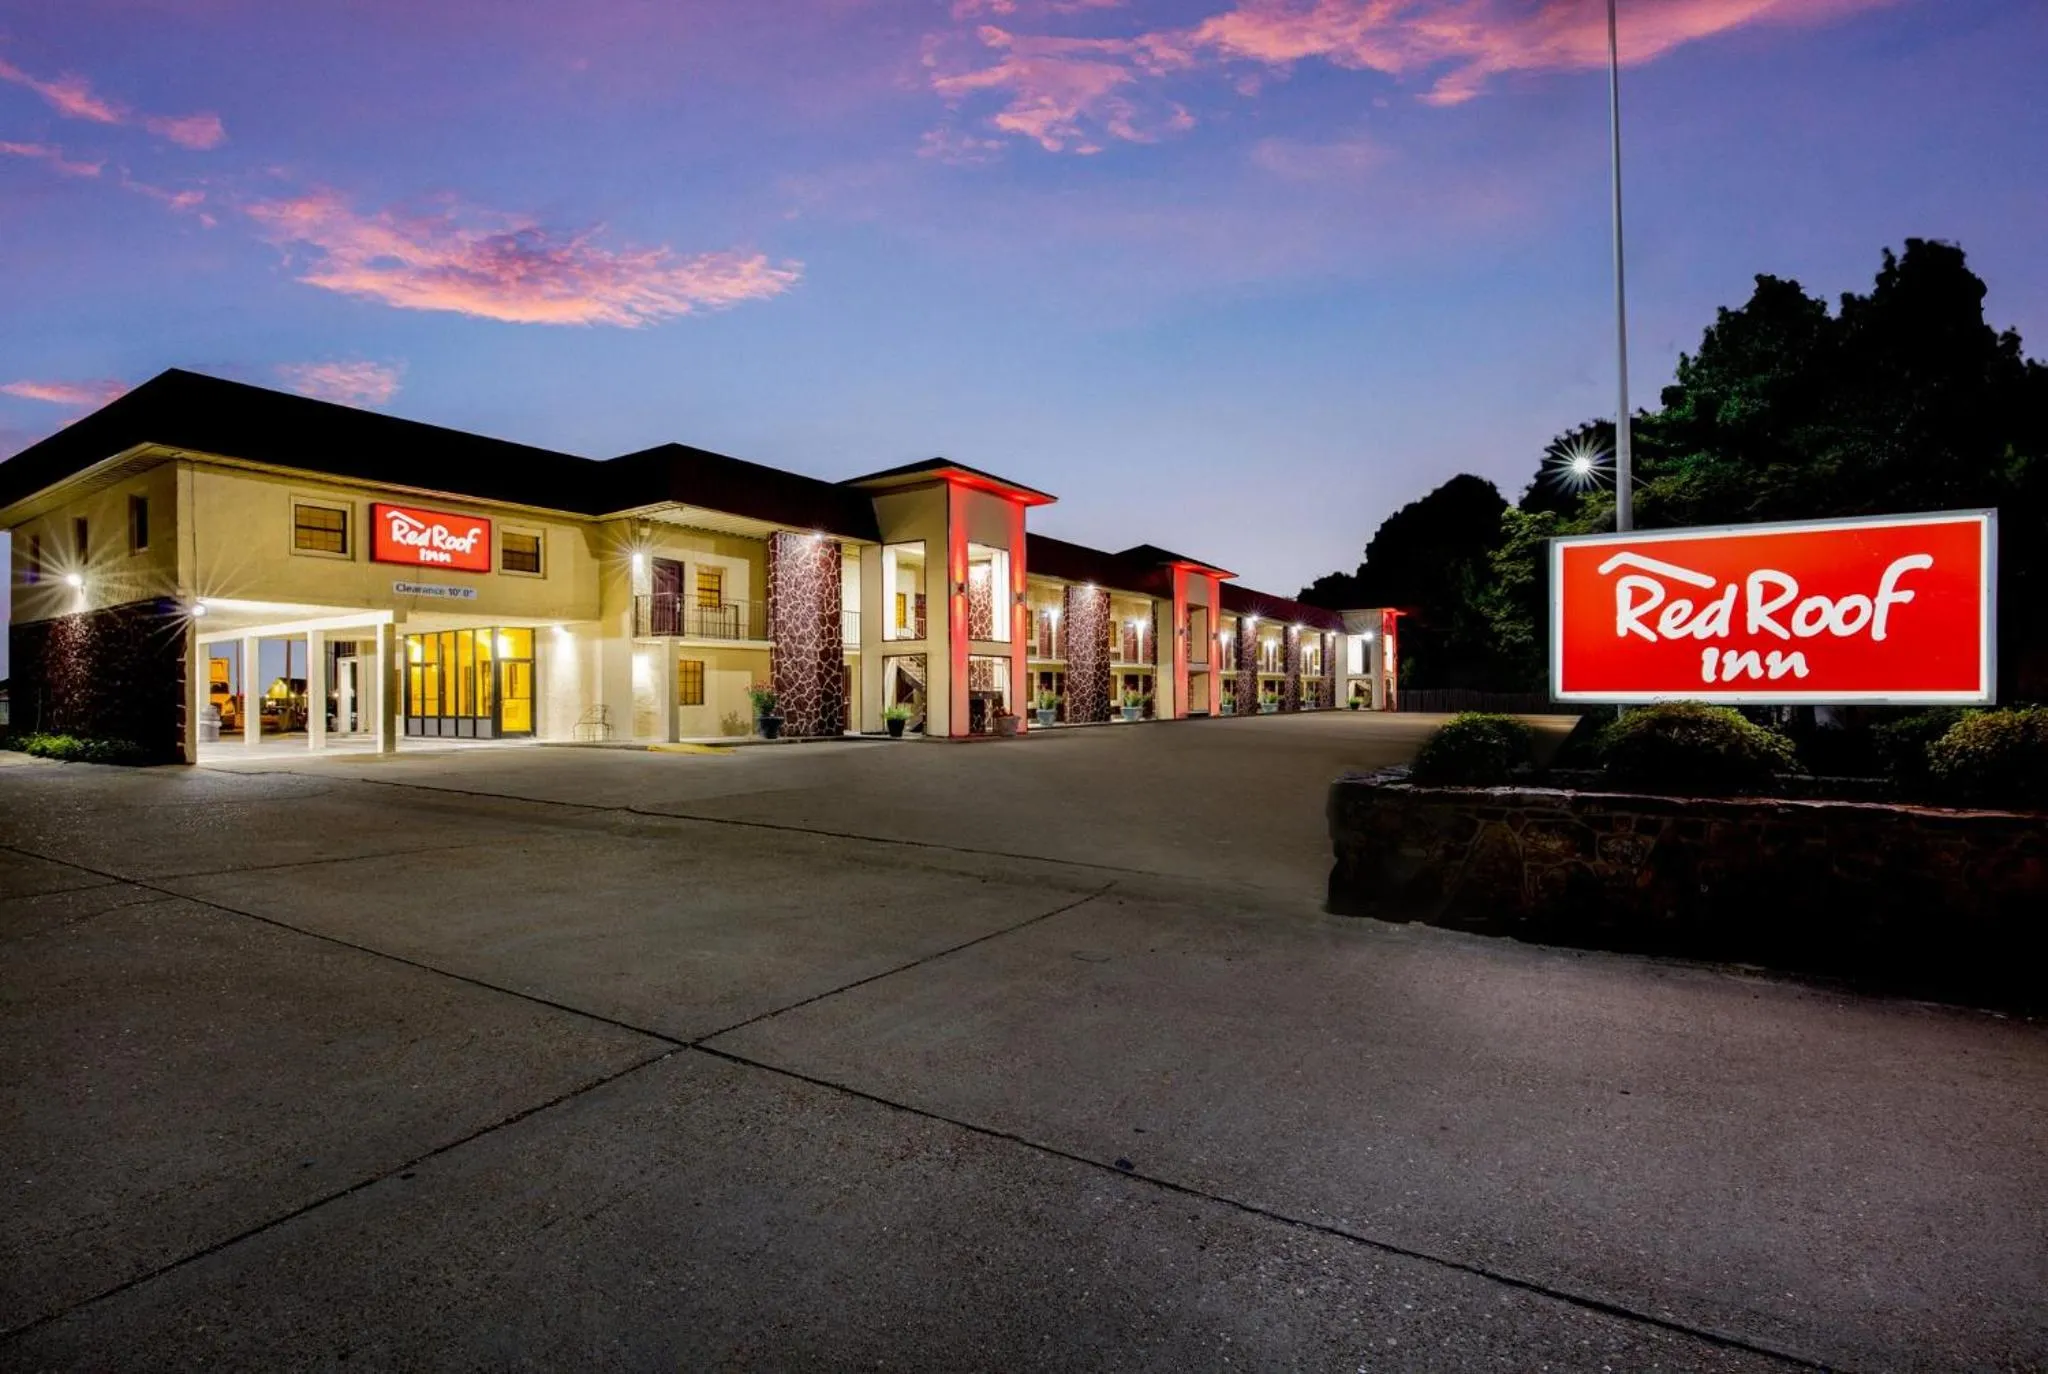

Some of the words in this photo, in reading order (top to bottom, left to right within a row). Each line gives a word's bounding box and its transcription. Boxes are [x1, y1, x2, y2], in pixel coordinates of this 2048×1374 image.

[392, 519, 432, 547] Red
[432, 524, 482, 553] Roof
[396, 583, 445, 595] Clearance
[1616, 574, 1738, 642] Red
[1746, 553, 1934, 642] Roof
